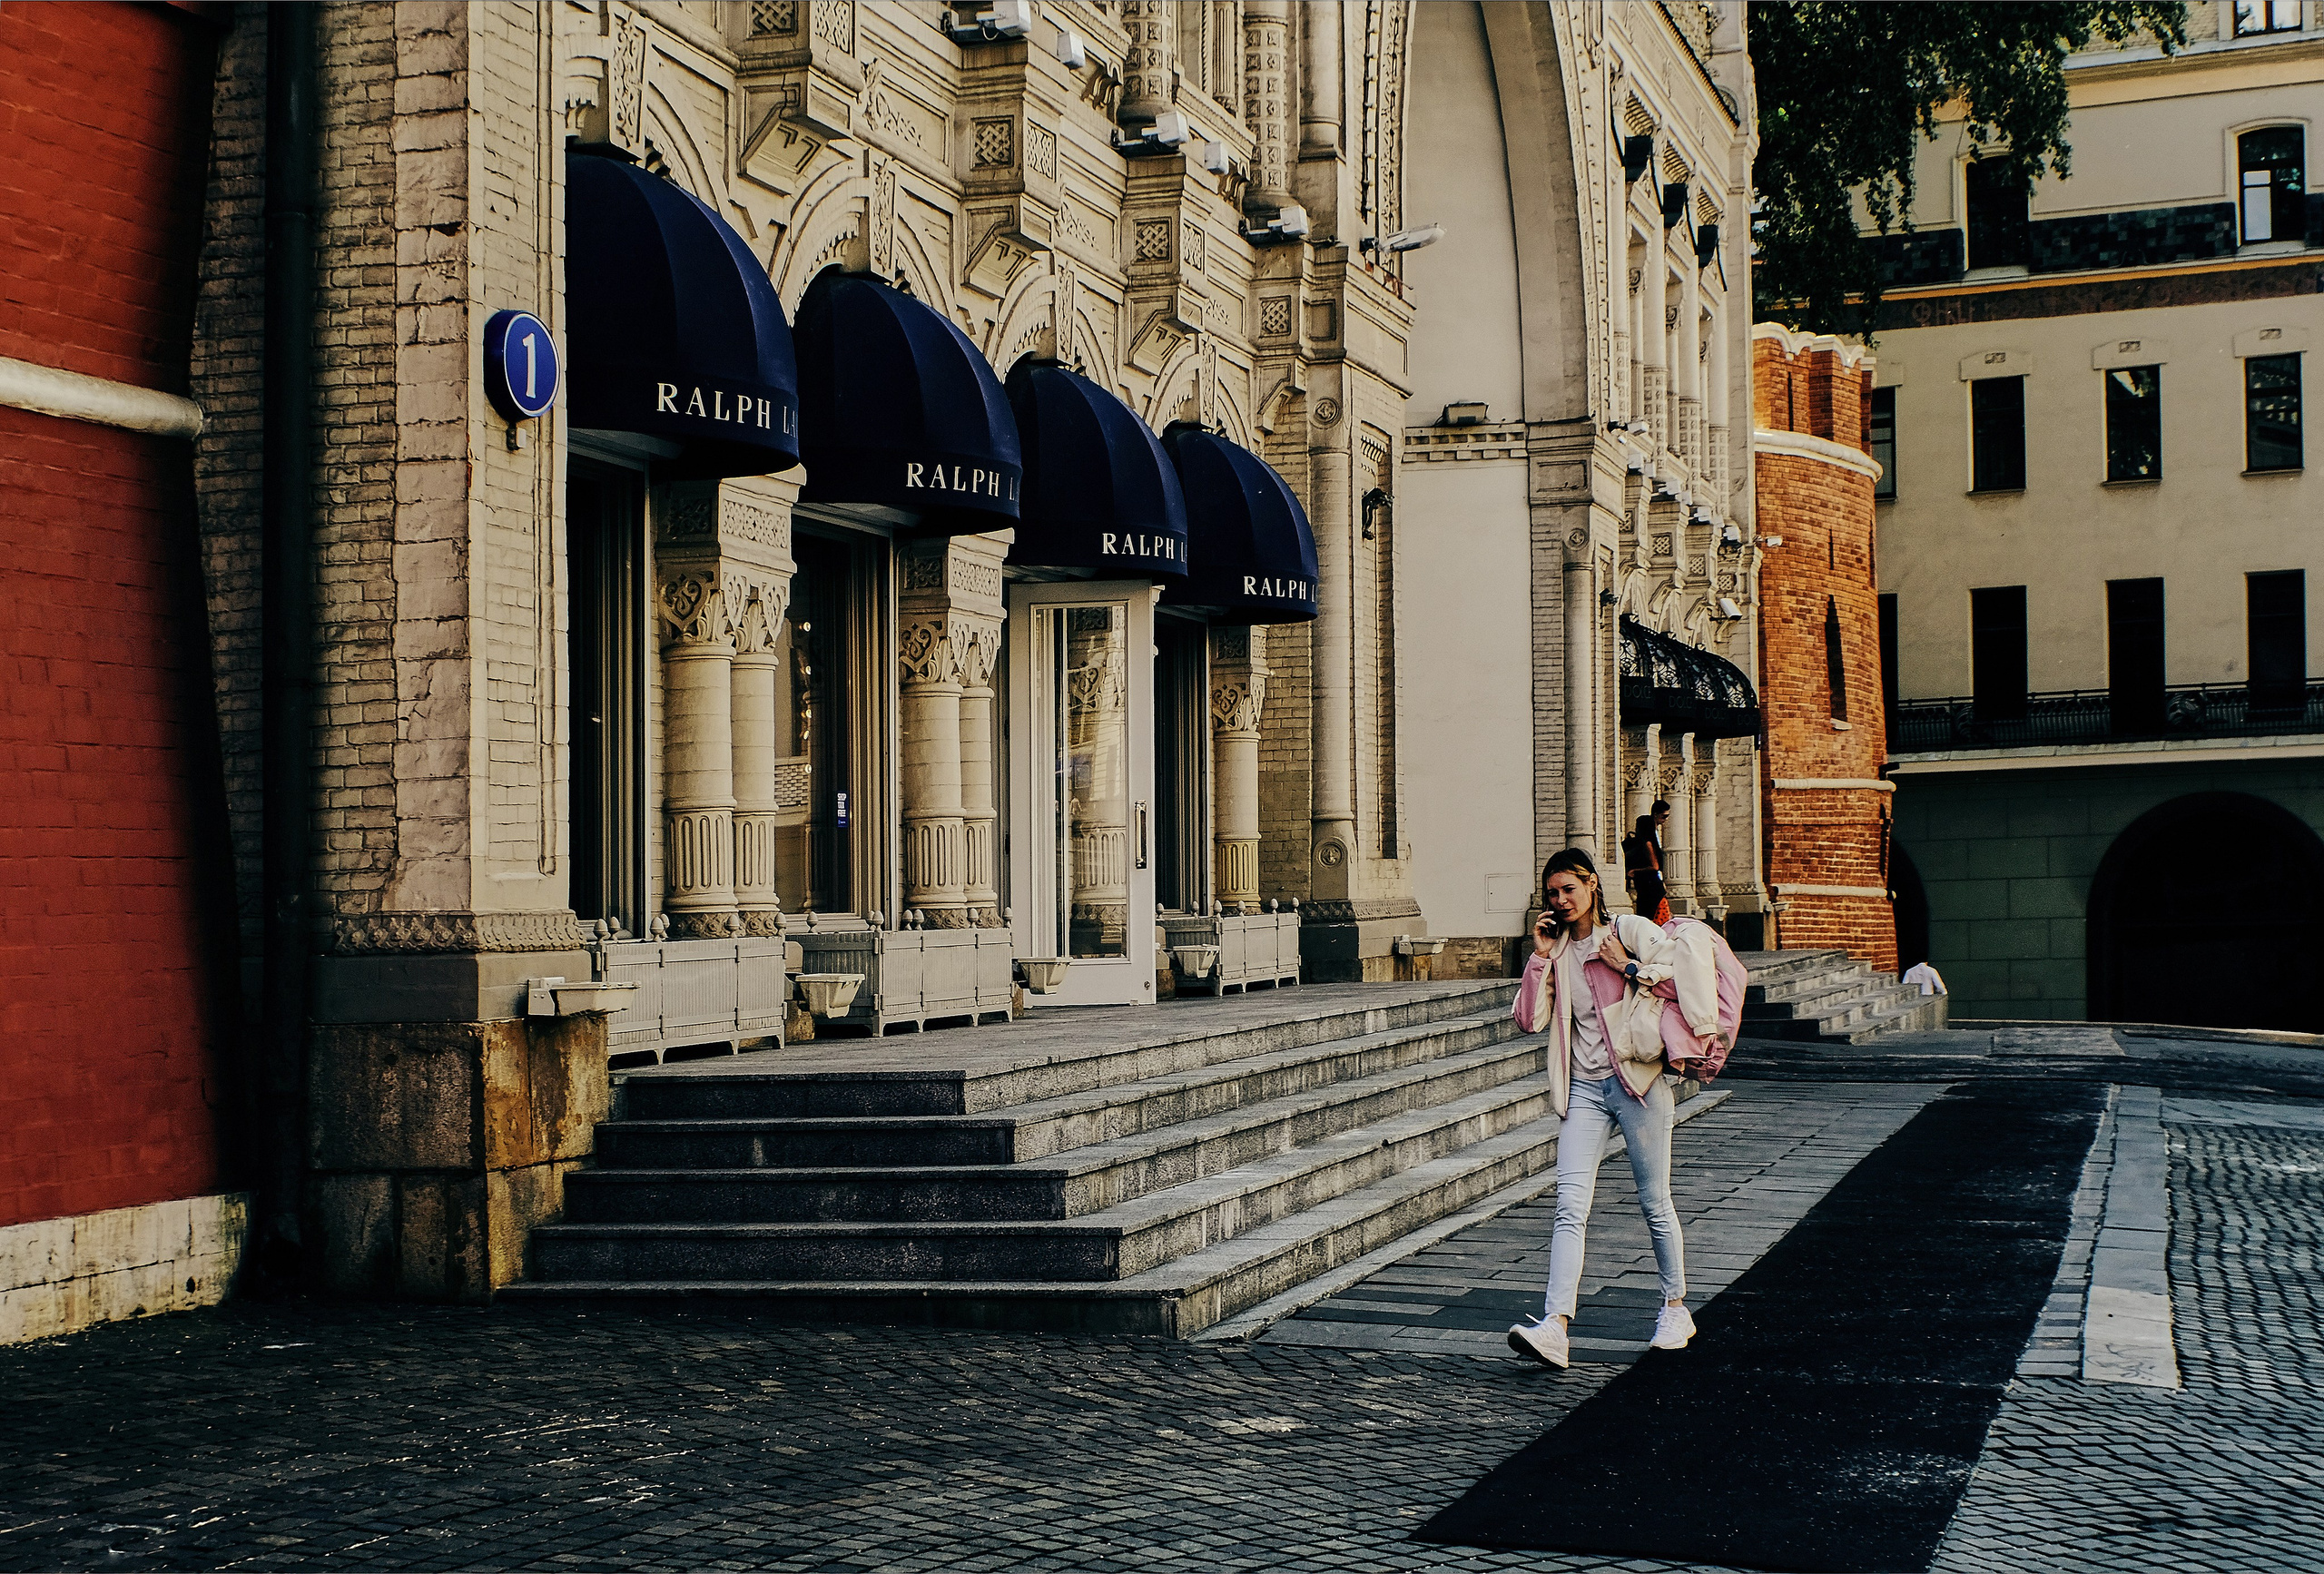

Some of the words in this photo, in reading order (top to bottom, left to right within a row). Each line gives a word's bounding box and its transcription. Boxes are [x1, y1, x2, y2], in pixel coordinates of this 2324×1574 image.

[522, 332, 537, 398] 1
[656, 382, 771, 429] RALPH
[905, 462, 1000, 497] RALPH
[1102, 533, 1175, 559] RALPH
[1243, 575, 1306, 600] RALPH
